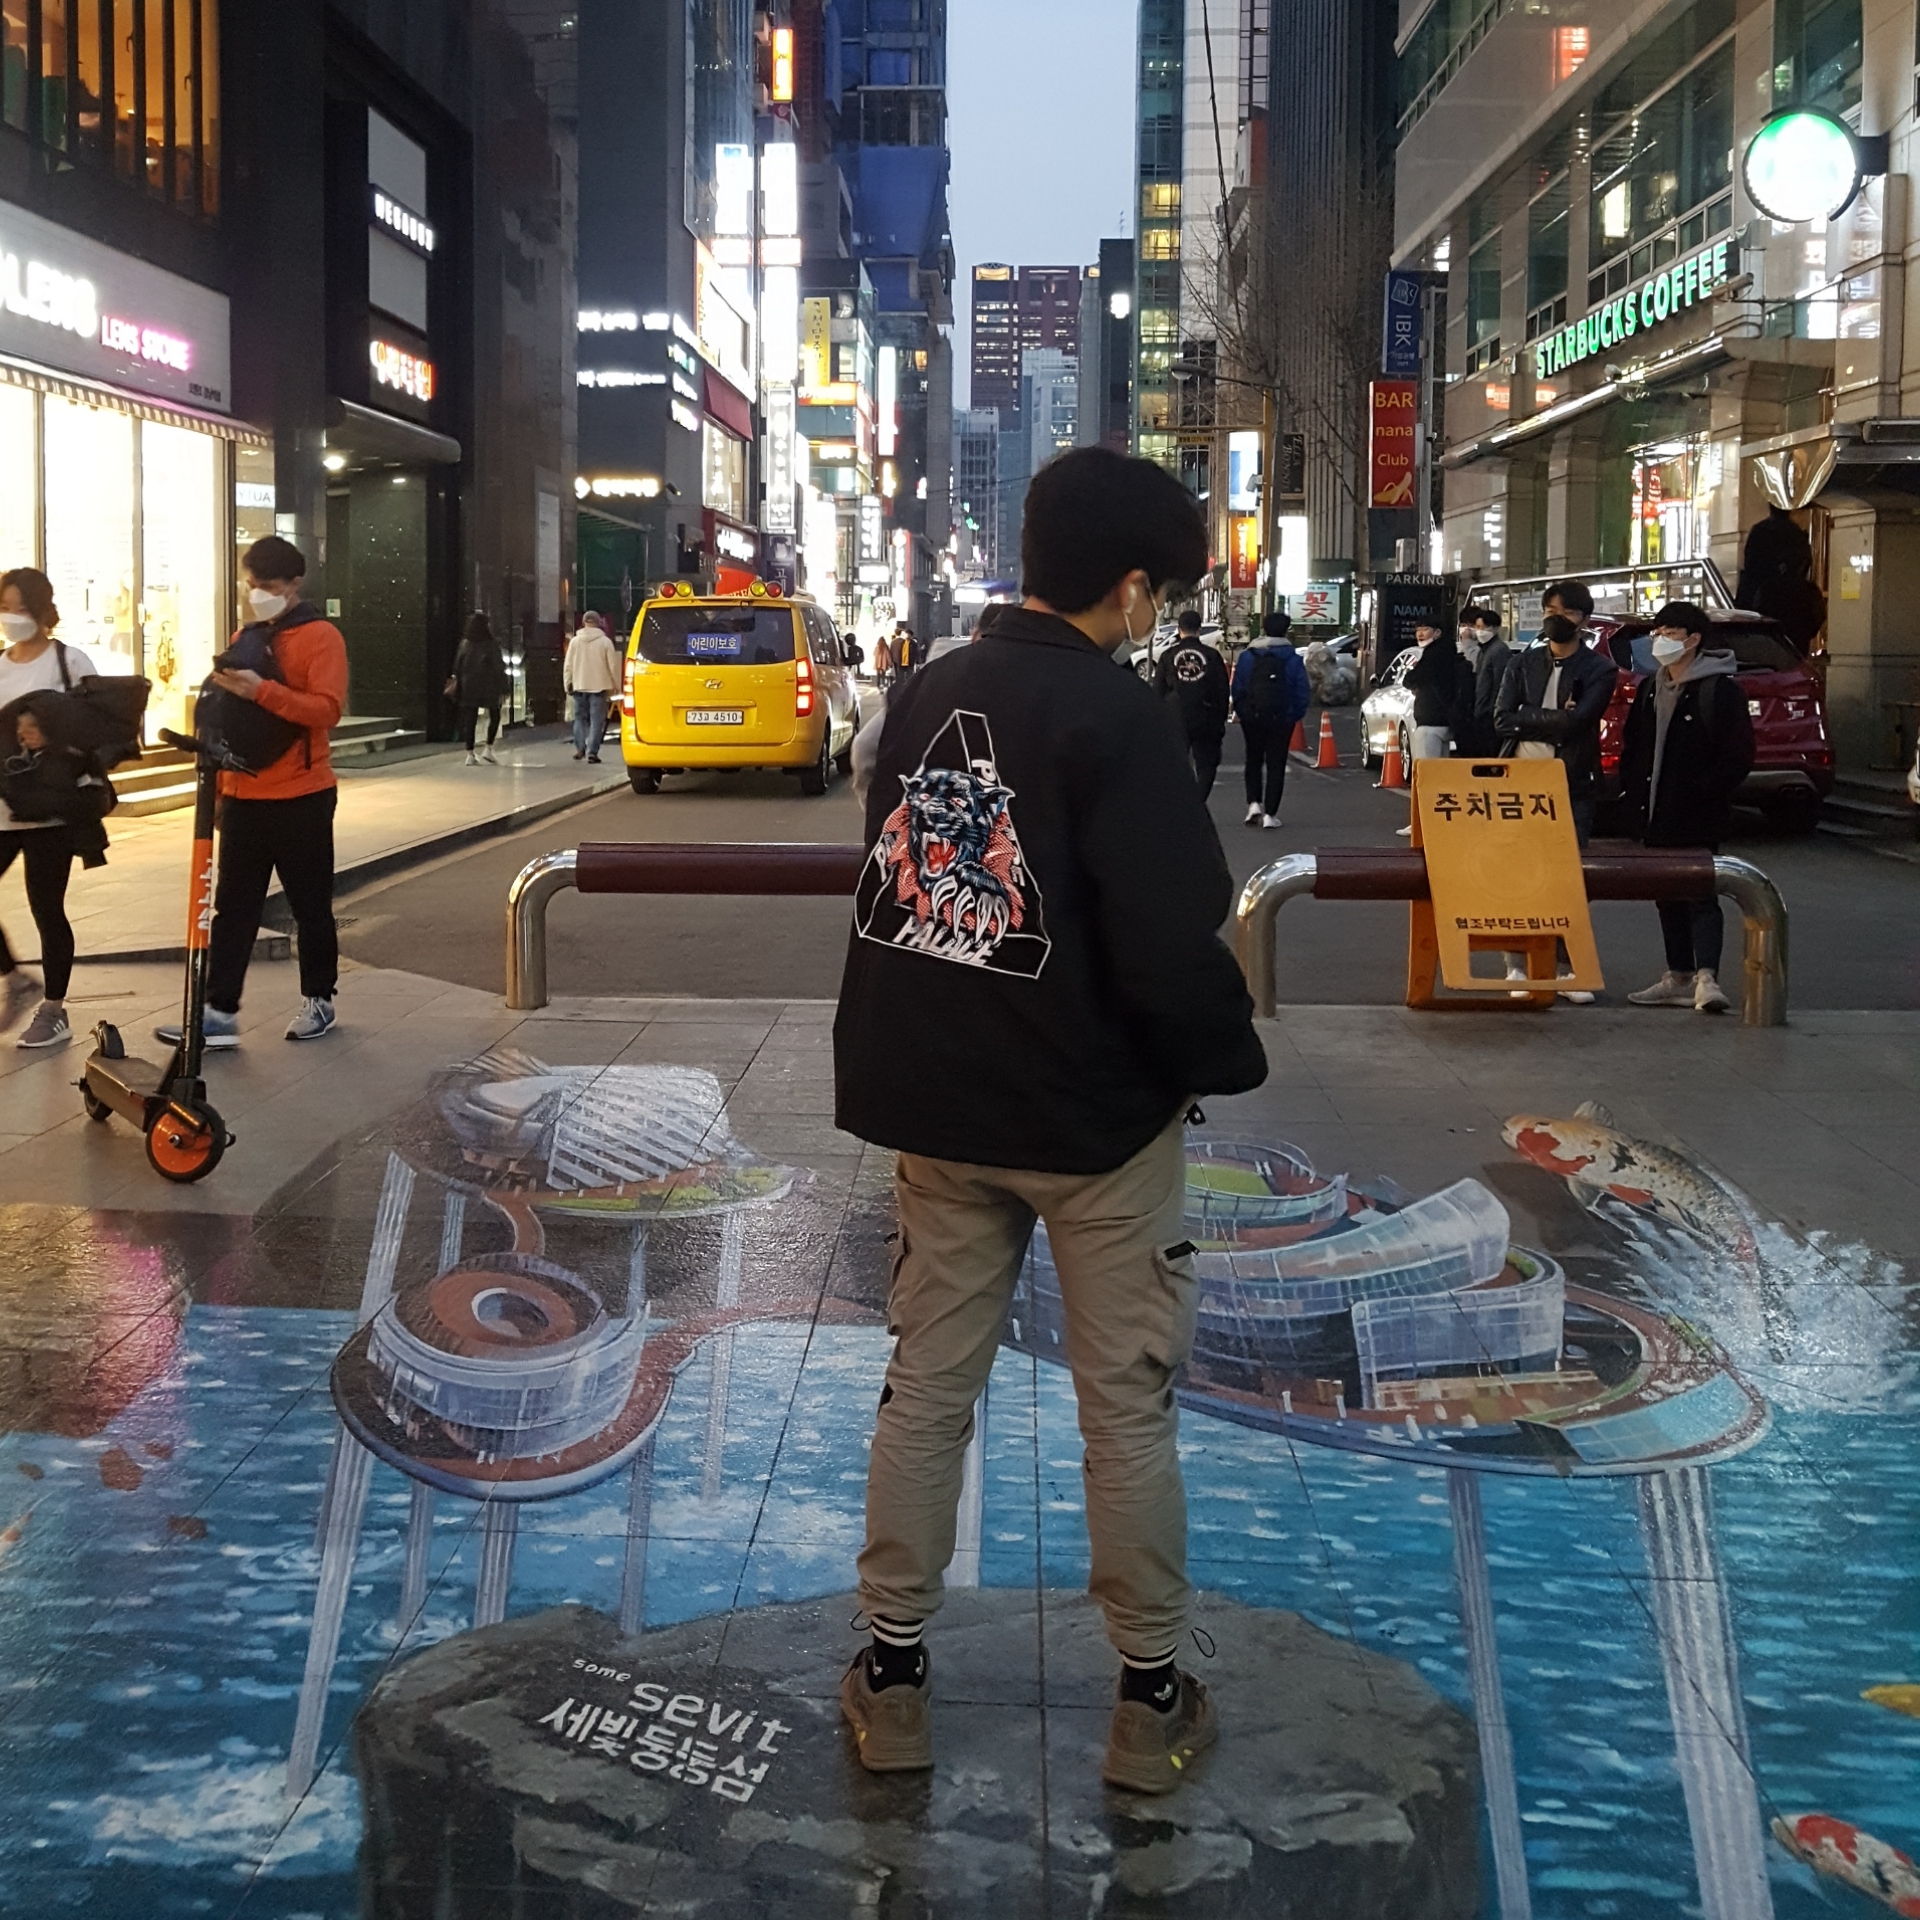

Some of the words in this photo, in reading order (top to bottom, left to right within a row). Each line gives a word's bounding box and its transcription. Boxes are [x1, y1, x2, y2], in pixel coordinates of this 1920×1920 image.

[1536, 291, 1637, 380] STARBUCKS
[1641, 240, 1729, 328] COFFEE
[1395, 314, 1412, 346] IBK
[101, 315, 138, 355] LENS
[140, 328, 189, 371] STORE
[1375, 392, 1414, 408] BAR
[1375, 425, 1414, 437] nana
[1377, 453, 1409, 466] Club
[1386, 573, 1446, 586] PARKING
[1297, 591, 1334, 619] 꽃
[690, 636, 738, 650] 어린이보호
[713, 712, 738, 722] 4510
[1433, 788, 1557, 822] 주차금지
[892, 915, 994, 965] PALACE
[572, 1658, 631, 1682] some
